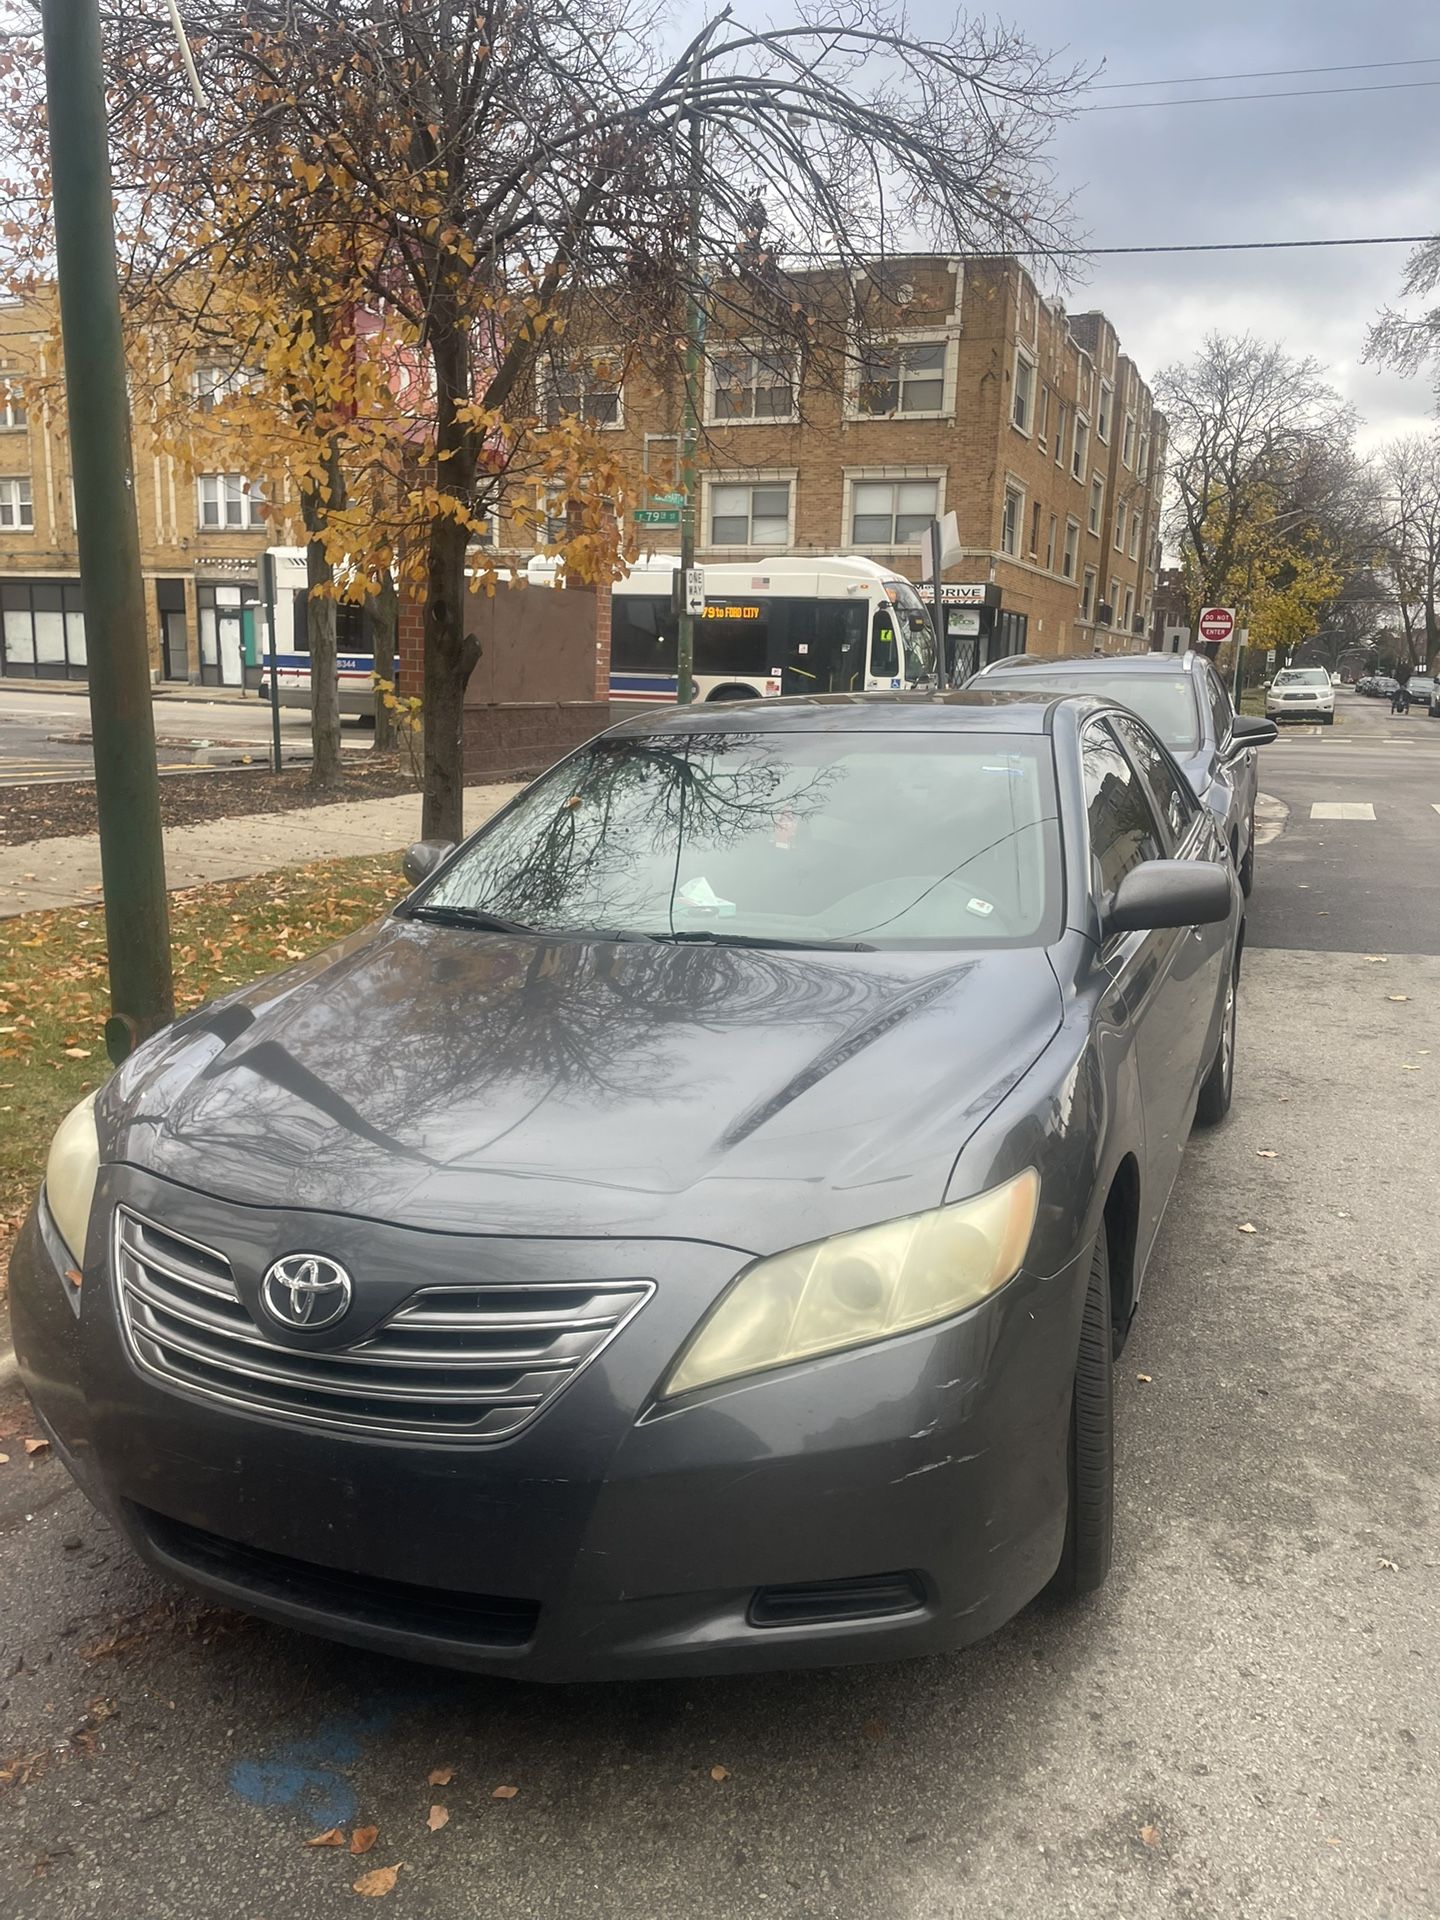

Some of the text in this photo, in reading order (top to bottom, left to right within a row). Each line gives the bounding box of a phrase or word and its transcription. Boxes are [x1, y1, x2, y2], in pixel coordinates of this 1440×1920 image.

[688, 572, 702, 584] ONE
[688, 585, 702, 595] WAY
[702, 607, 759, 618] 79 to FORD CITY
